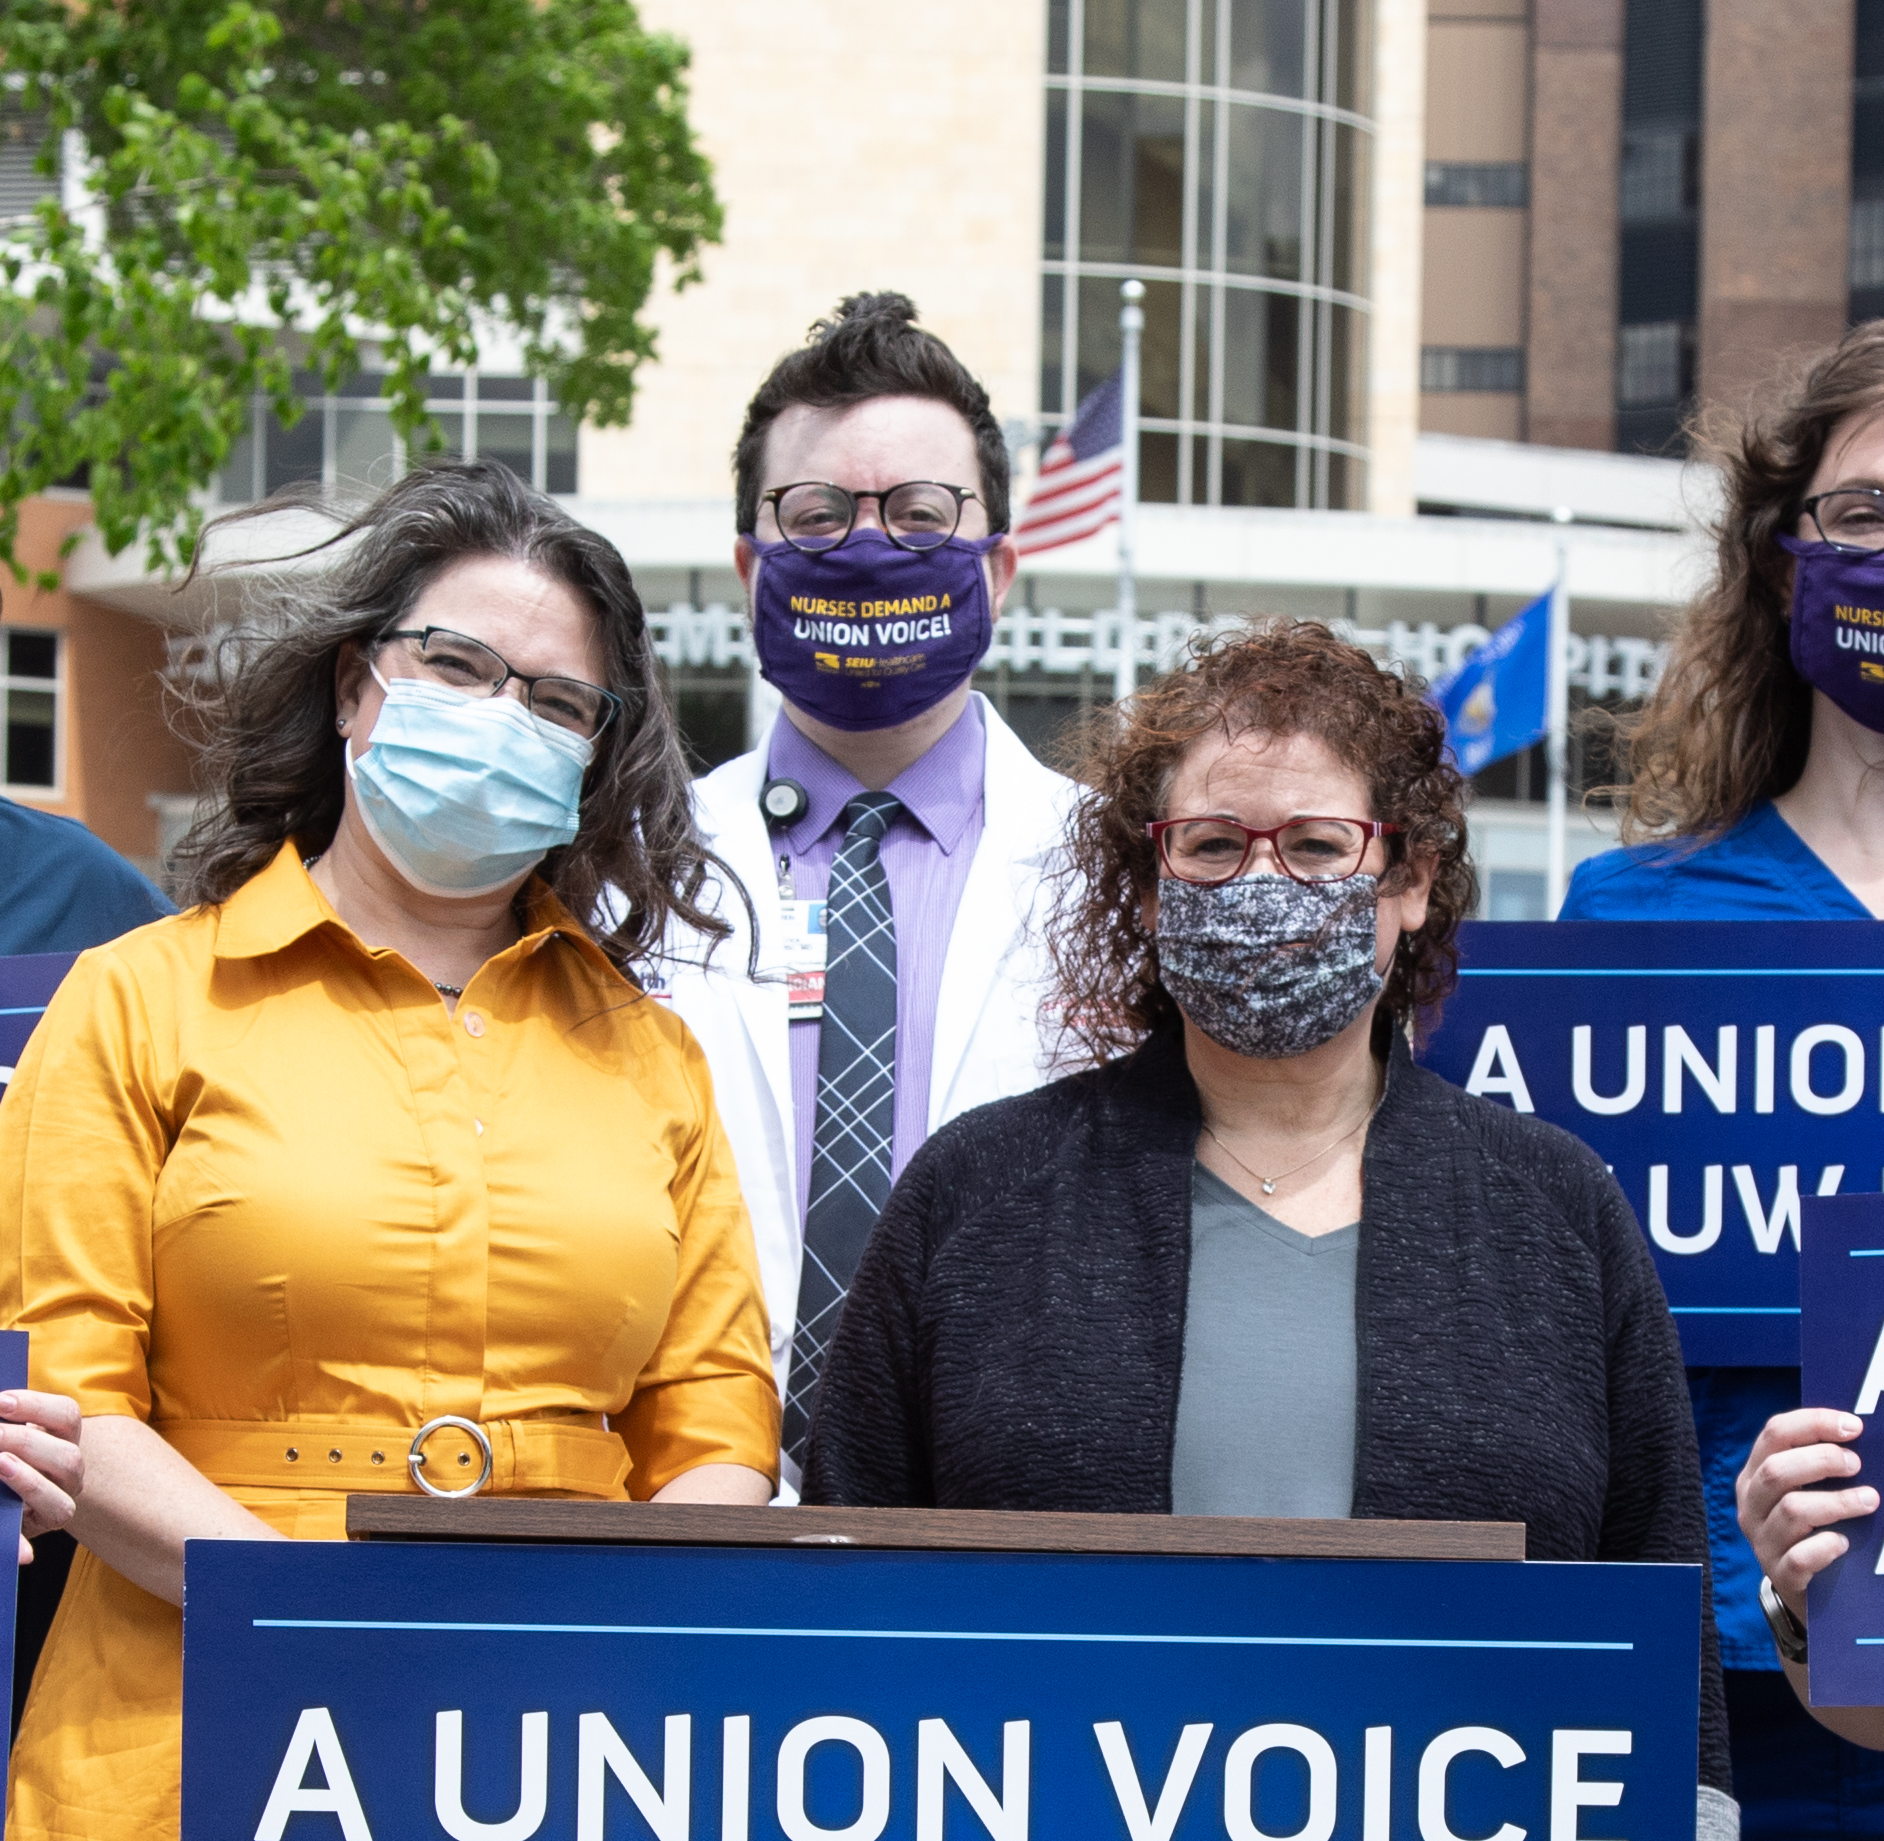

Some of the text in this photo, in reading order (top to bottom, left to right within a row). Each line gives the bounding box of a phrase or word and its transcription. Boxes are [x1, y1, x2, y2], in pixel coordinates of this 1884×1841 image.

[790, 593, 951, 618] NURSES DEMAND A
[794, 617, 869, 646] UNION
[875, 614, 952, 645] VOICE!
[1465, 1024, 1535, 1115] A
